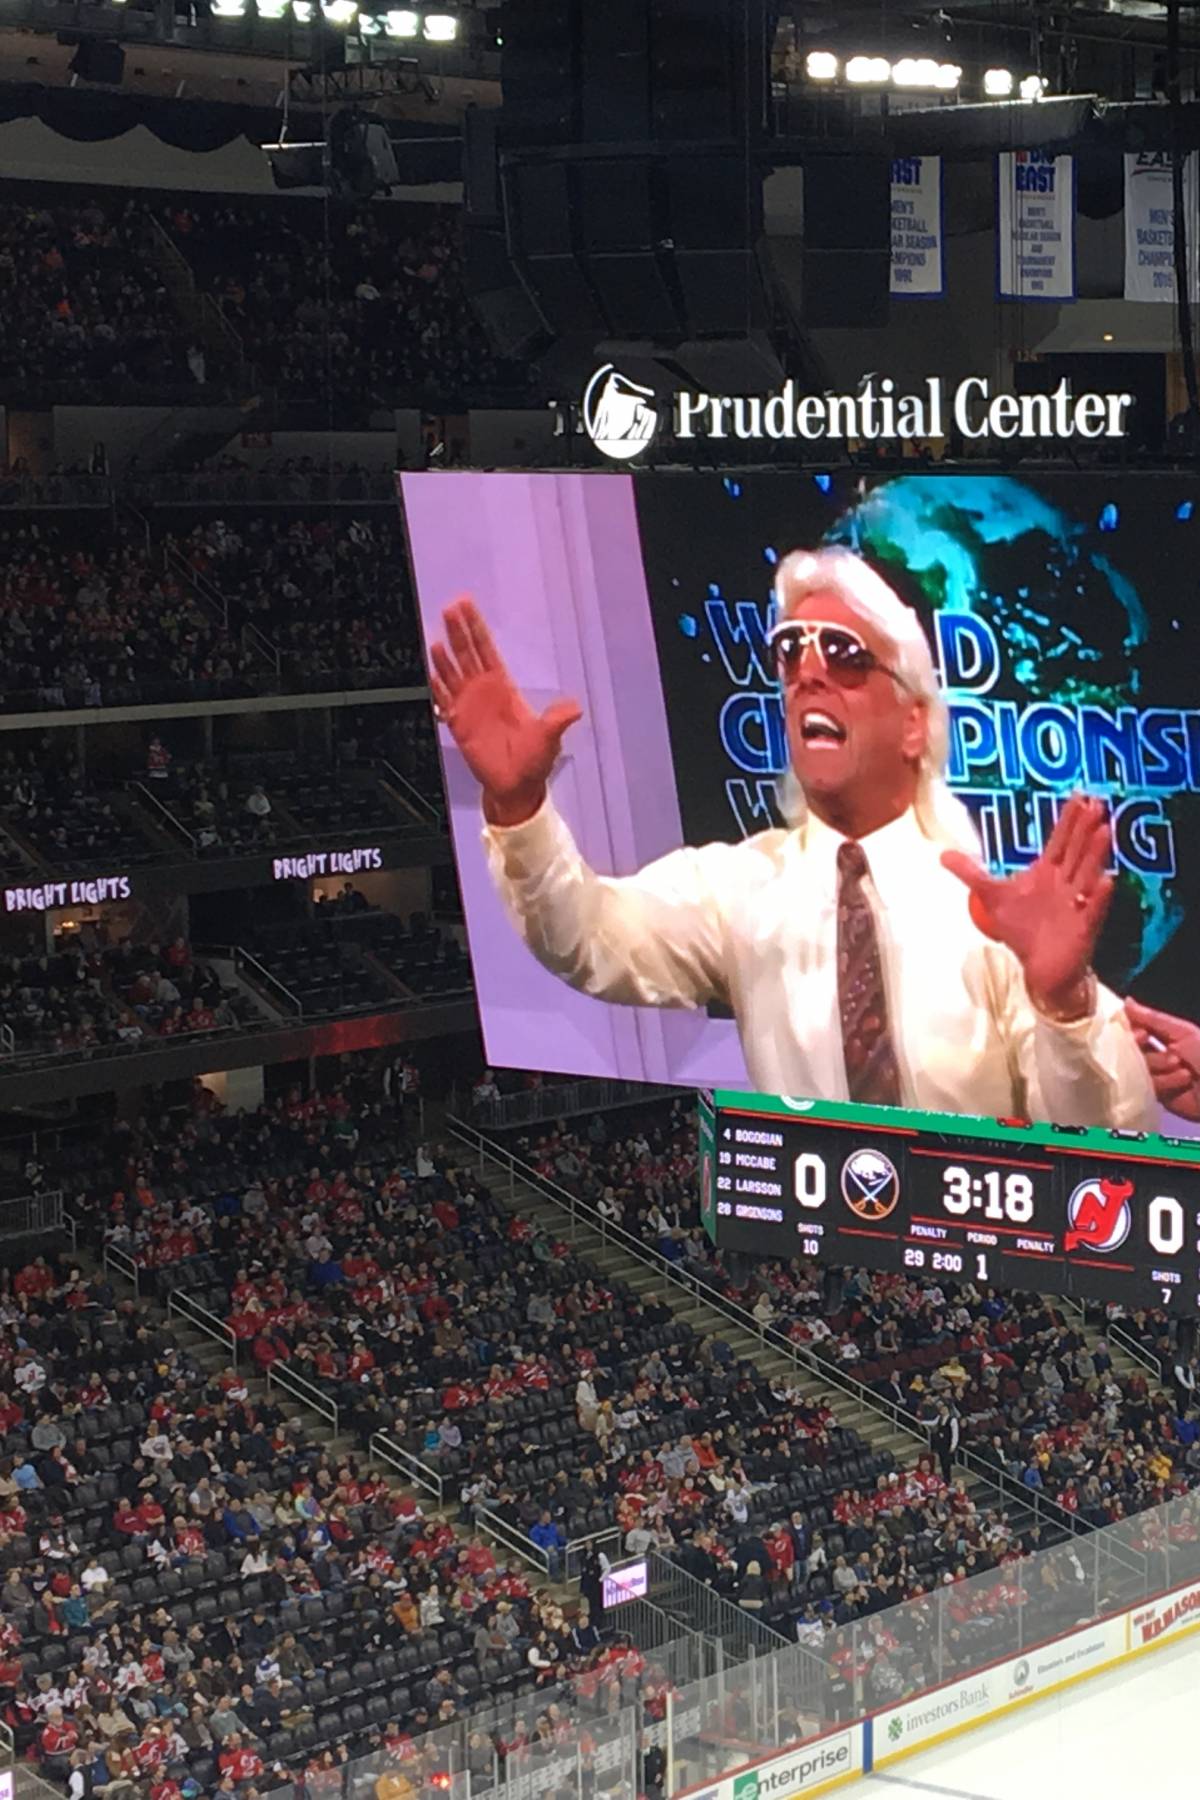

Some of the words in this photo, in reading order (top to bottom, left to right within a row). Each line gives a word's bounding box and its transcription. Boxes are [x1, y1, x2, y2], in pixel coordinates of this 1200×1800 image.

[891, 159, 922, 185] AST
[1016, 165, 1055, 192] EAST
[891, 217, 928, 233] KETBALL
[1137, 229, 1174, 246] BASKETB
[675, 378, 944, 439] Prudential
[954, 377, 1133, 439] Center
[273, 854, 327, 880] BRIGHT
[330, 848, 382, 873] LIGHTS
[5, 882, 67, 911] BRIGHT
[71, 877, 130, 905] LIGHTS
[723, 1128, 731, 1141] 4
[735, 1153, 776, 1171] MCCABE
[717, 1176, 731, 1191] 22
[735, 1178, 781, 1197] LARSSON
[795, 1153, 826, 1208] 0
[942, 1165, 1034, 1223] 3:18
[797, 1222, 824, 1236] SHOTS
[910, 1224, 947, 1240] PENALTY
[967, 1232, 998, 1246] PERIOD
[1016, 1238, 1055, 1253] PENALTY
[1148, 1196, 1184, 1254] 0
[803, 1240, 819, 1255] 10
[904, 1249, 925, 1267] 29
[932, 1253, 962, 1272] 2:00
[976, 1254, 988, 1281] 1
[1161, 1288, 1172, 1304] 7
[906, 1683, 990, 1732] investorsBank
[738, 1746, 849, 1800] enterprise
